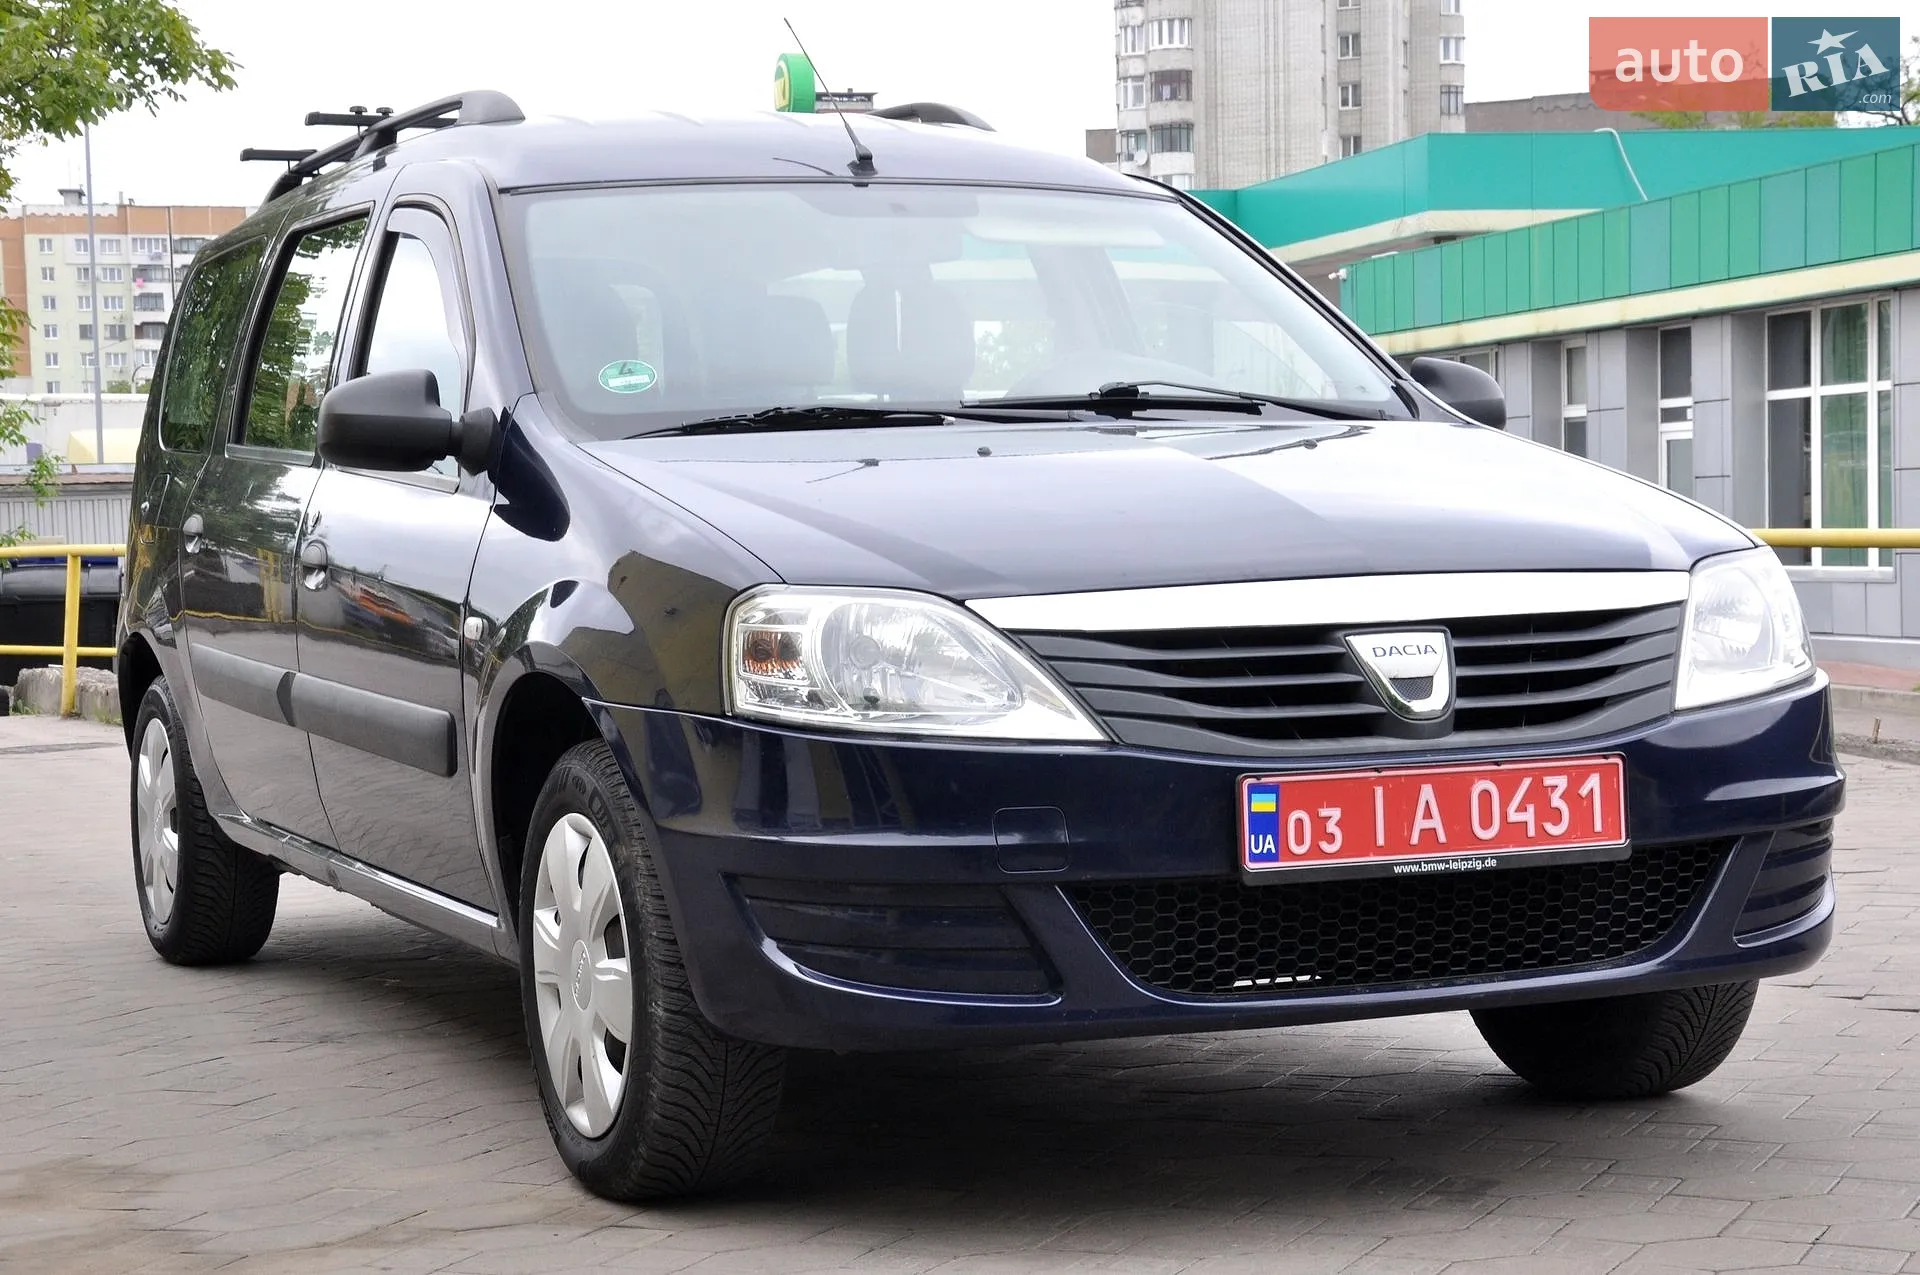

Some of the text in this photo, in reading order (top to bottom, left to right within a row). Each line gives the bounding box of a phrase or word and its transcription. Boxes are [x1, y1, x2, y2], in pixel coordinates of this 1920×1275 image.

[1371, 644, 1438, 658] DACIA
[1470, 772, 1603, 841] 0431
[1250, 834, 1276, 855] UA
[1393, 857, 1498, 875] www.bmw-leipzig.de
